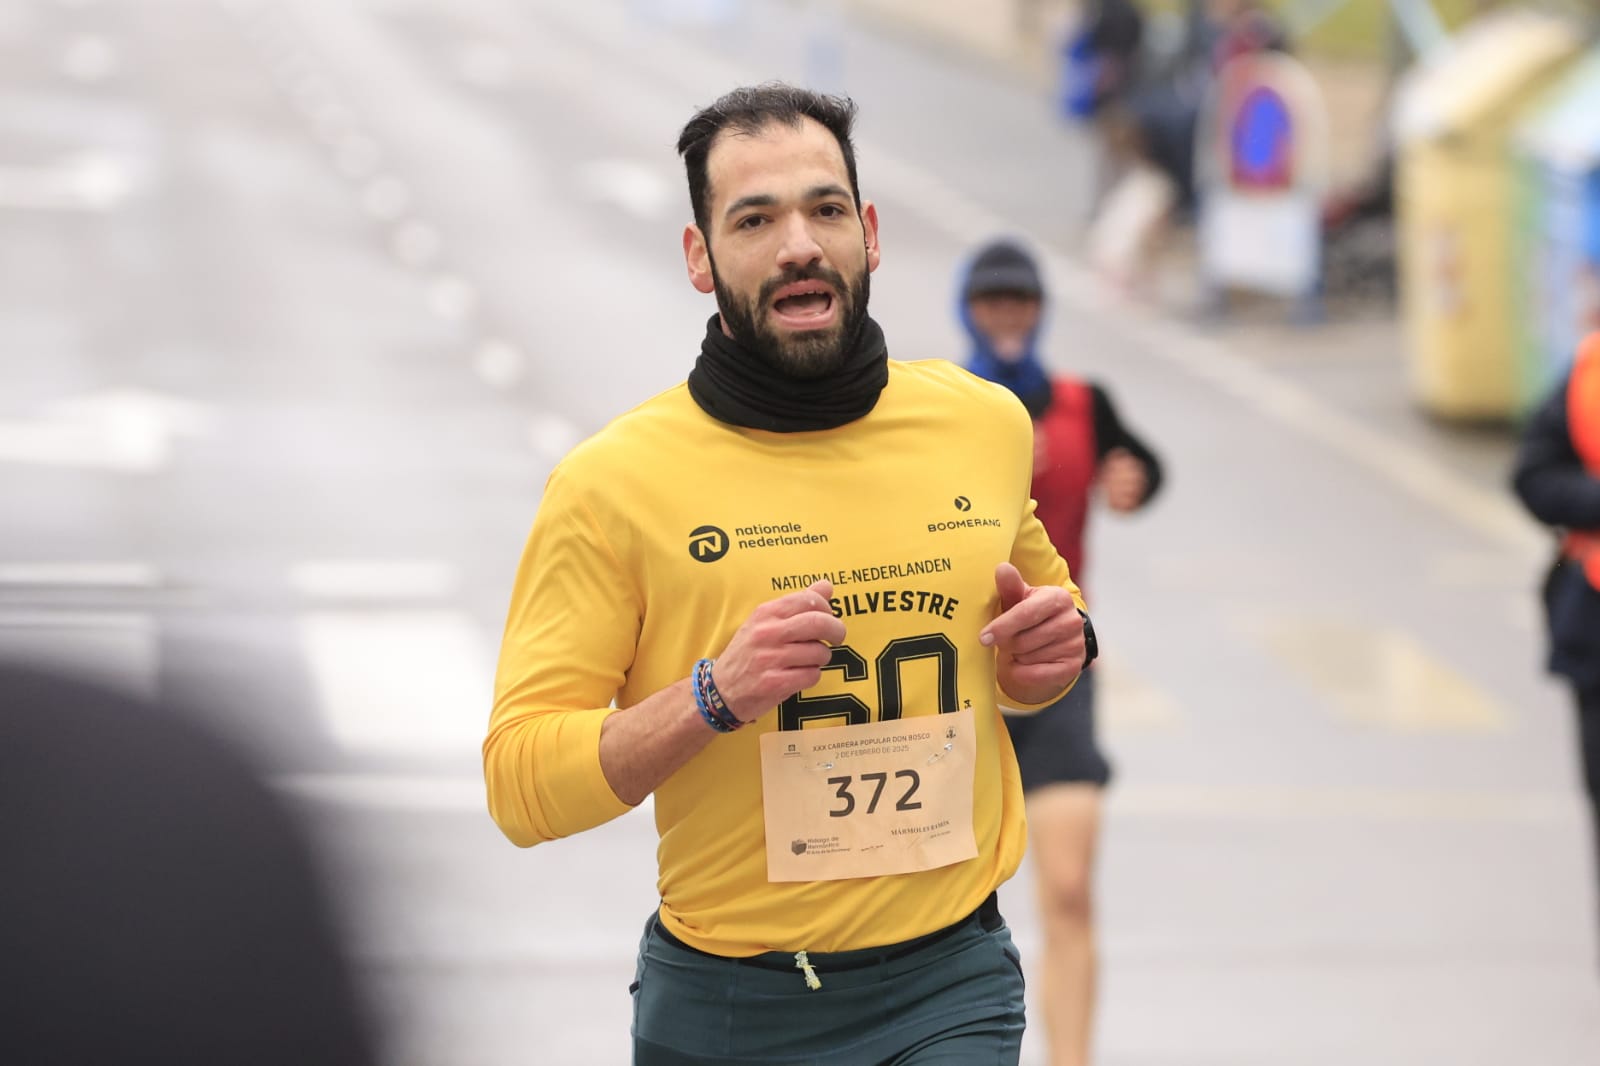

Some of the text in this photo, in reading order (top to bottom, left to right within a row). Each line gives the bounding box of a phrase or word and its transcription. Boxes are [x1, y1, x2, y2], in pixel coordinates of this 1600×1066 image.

[735, 522, 802, 537] nationale
[927, 519, 1001, 532] BOOMERANG
[738, 533, 828, 549] nederlanden
[830, 590, 959, 620] SILVESTRE
[827, 740, 859, 750] CARRERA
[860, 736, 892, 747] POPULAR
[892, 735, 907, 743] DON
[908, 732, 930, 741] BOSCO
[827, 769, 922, 817] 372
